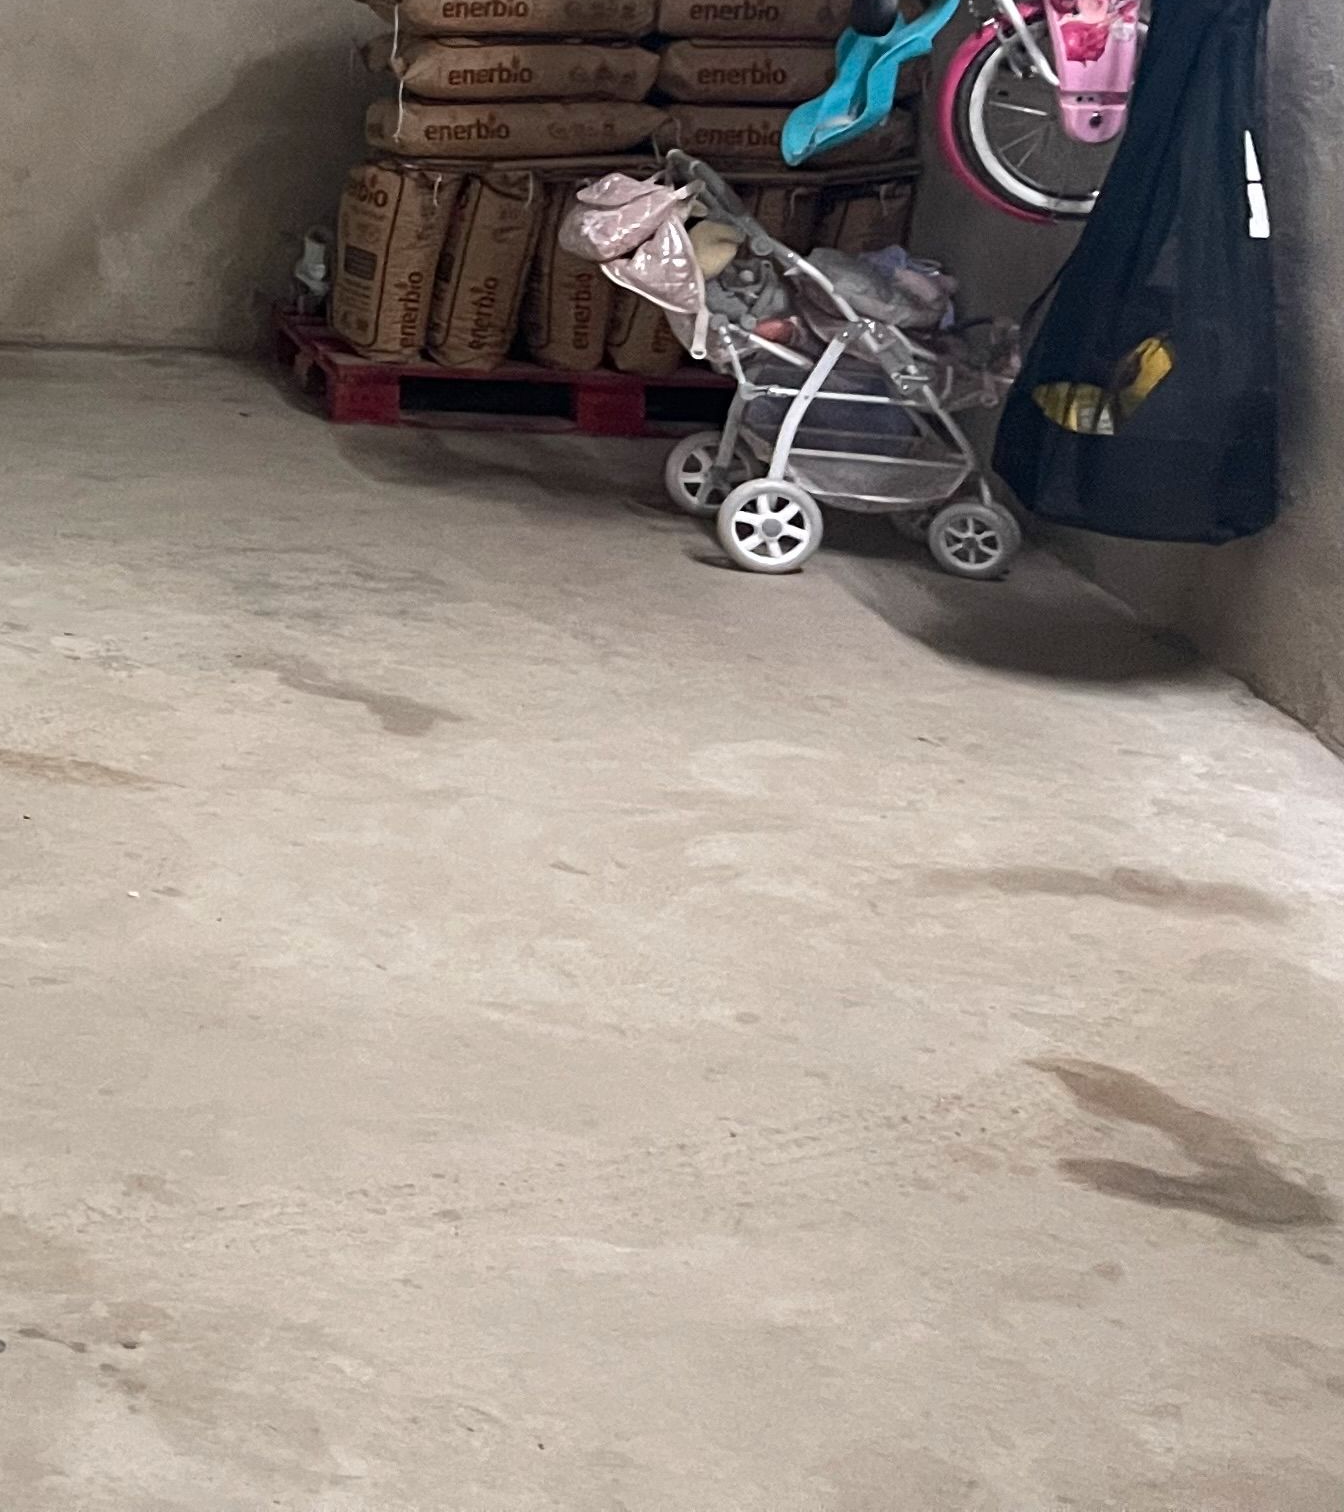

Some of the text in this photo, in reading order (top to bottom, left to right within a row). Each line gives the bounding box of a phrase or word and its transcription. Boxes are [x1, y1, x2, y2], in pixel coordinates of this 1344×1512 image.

[448, 53, 533, 85] enerbio
[697, 57, 787, 85] enerbio
[424, 112, 510, 140] enerbio
